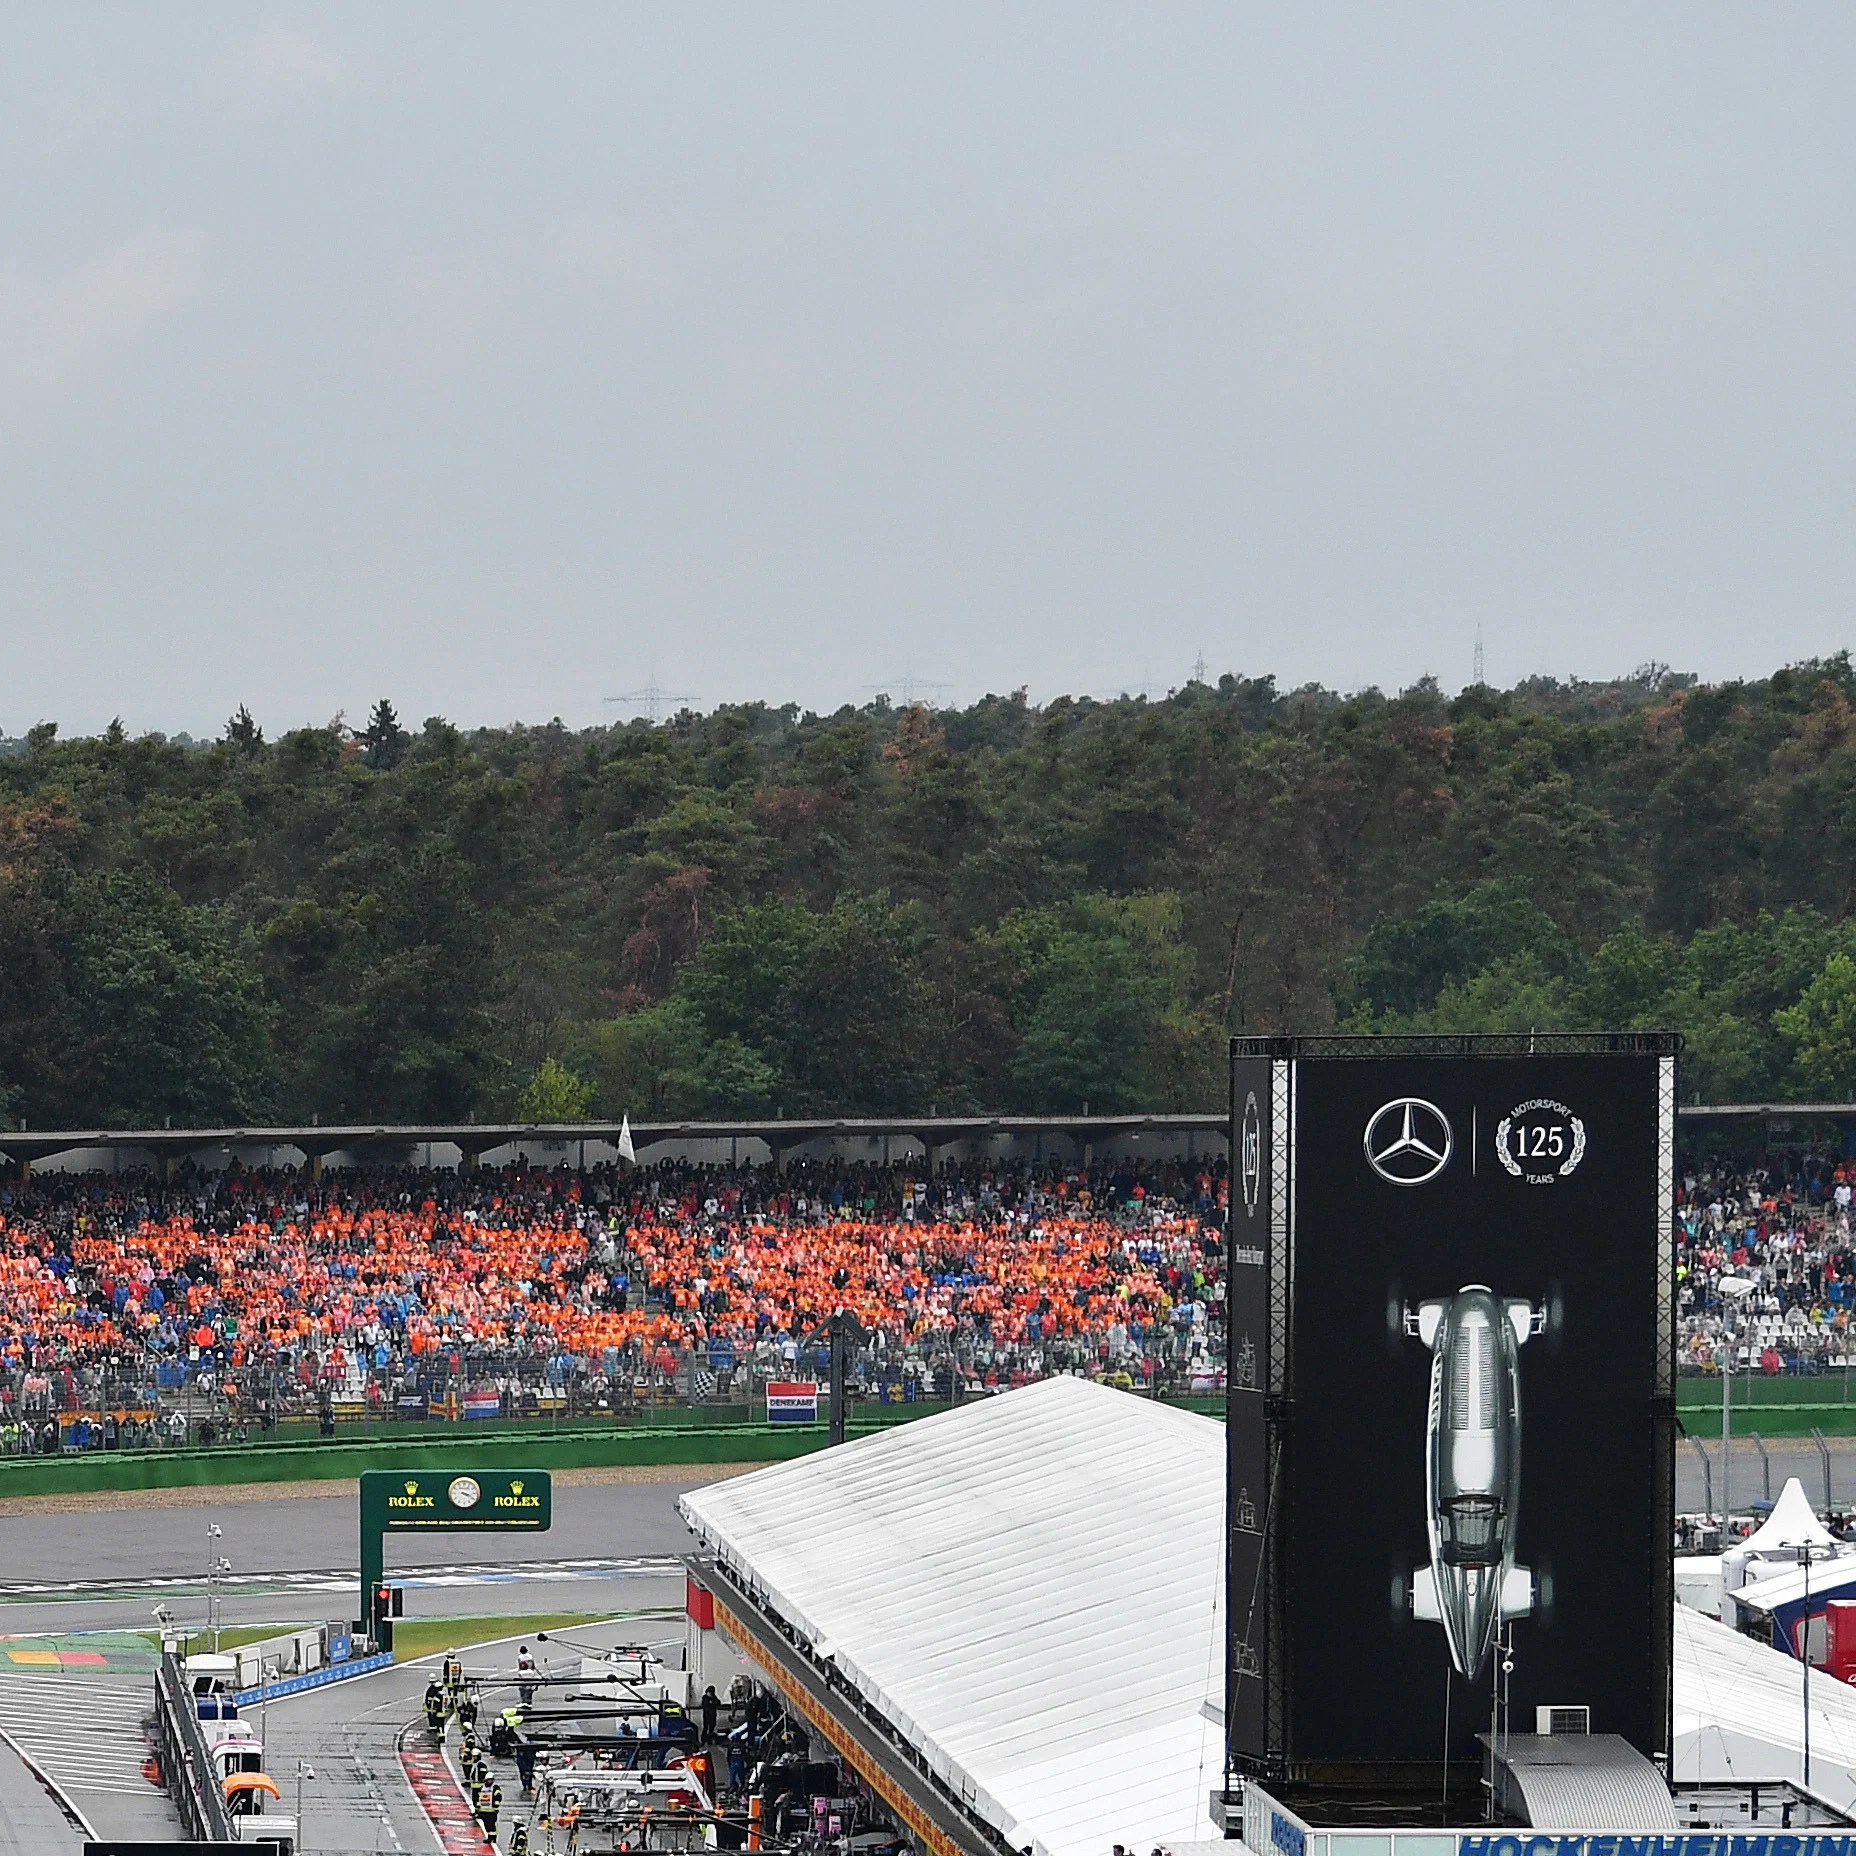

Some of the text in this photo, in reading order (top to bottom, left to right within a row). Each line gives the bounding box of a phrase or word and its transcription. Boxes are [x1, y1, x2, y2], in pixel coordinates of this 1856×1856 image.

[1510, 1099, 1573, 1118] MOTORSPORT
[1516, 1125, 1564, 1157] 125
[1526, 1173, 1555, 1185] YEARS
[388, 1497, 435, 1507] ROLEX
[494, 1497, 541, 1507] ROLEX
